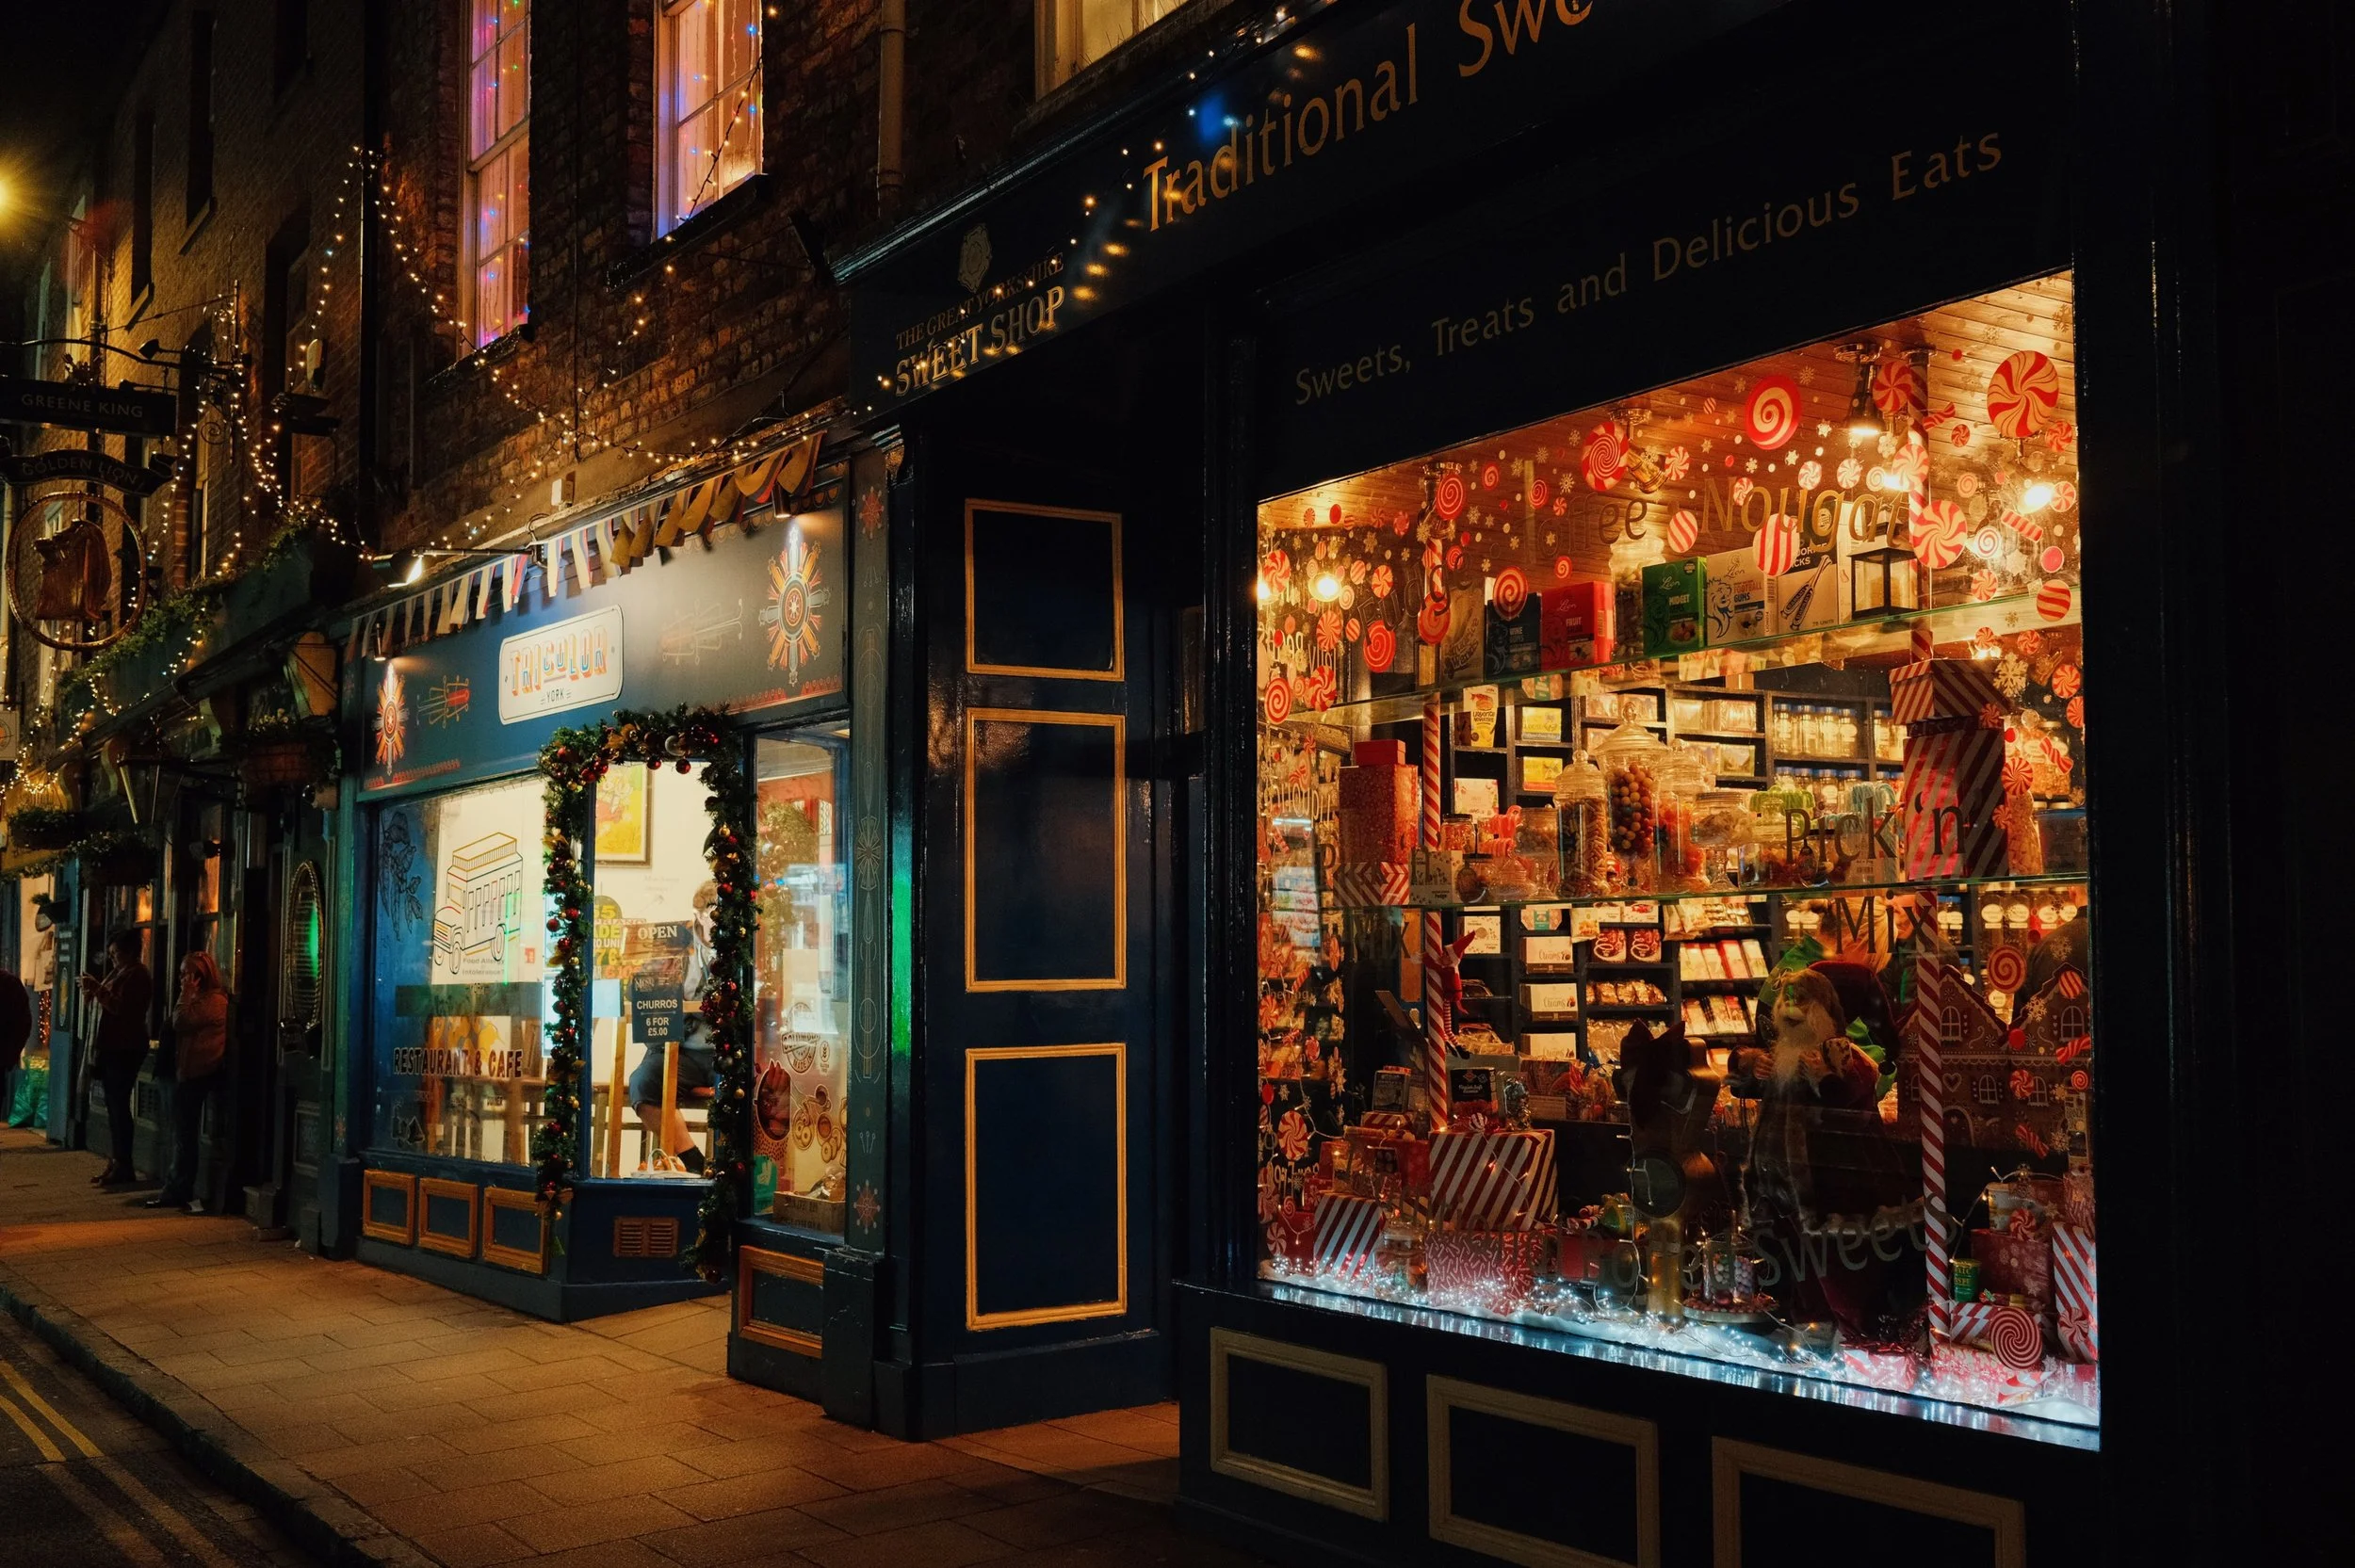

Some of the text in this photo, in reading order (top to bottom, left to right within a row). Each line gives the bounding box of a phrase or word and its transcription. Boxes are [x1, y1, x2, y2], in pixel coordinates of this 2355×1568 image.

[1143, 23, 1419, 233] Traditional
[1294, 131, 2004, 406] Sweets, Treats and Delicious Eats
[896, 284, 1065, 396] SWEET SHOP
[897, 322, 925, 350] THE
[927, 298, 976, 335] GREAT
[21, 393, 91, 413] GREENE
[98, 401, 143, 418] KING
[22, 457, 139, 485] GOLDEN LION
[1700, 477, 1909, 552] Nougat
[510, 624, 608, 697] TRICOLOR
[546, 687, 565, 703] YORK
[1785, 796, 1897, 864] Pick
[638, 925, 678, 940] OPEN
[1837, 889, 1932, 955] Mix
[637, 999, 678, 1010] CHURROS
[645, 1017, 670, 1026] 6 FOR
[647, 1026, 668, 1037] £5.00
[394, 1046, 524, 1078] RESTAURANT & CAFE
[1753, 1191, 1959, 1287] Sweets
